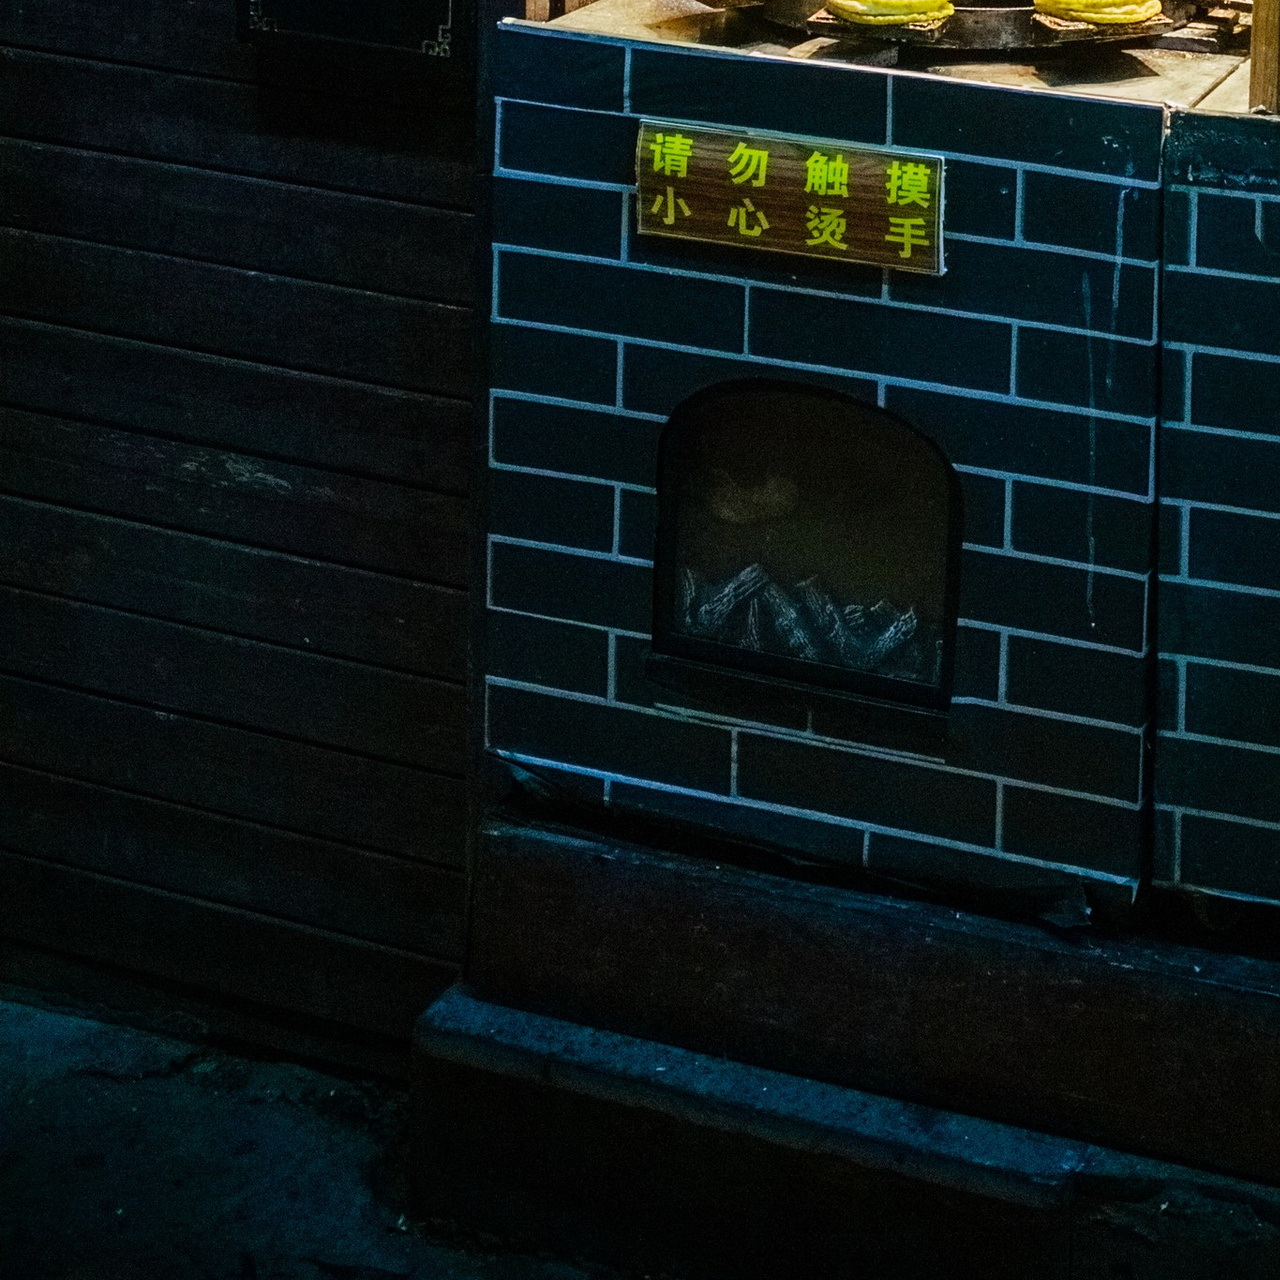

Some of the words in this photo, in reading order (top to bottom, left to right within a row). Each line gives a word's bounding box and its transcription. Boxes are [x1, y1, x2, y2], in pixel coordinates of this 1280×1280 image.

[650, 132, 931, 209] 请勿触摸
[651, 186, 931, 259] 小心烫手
